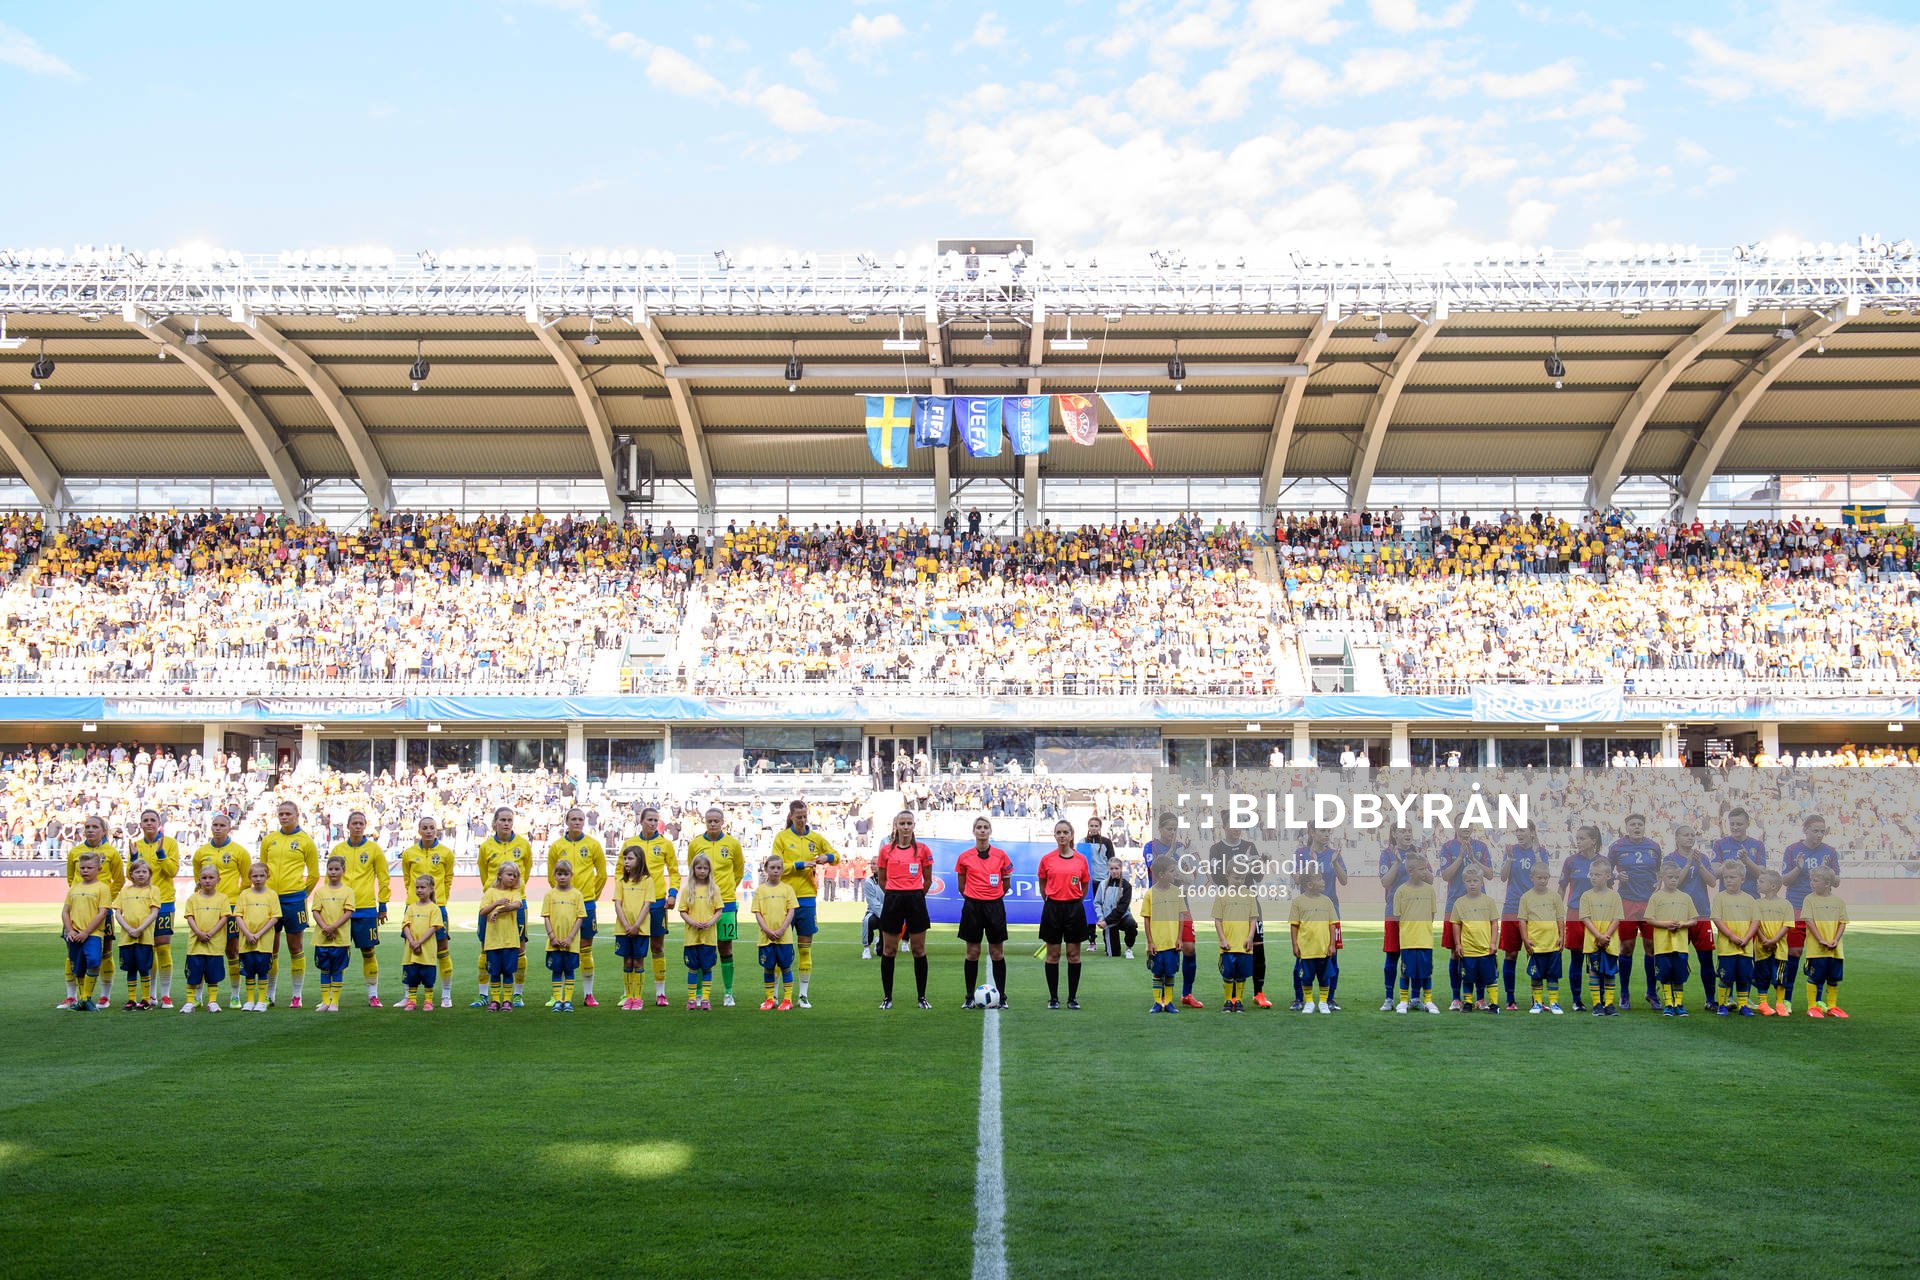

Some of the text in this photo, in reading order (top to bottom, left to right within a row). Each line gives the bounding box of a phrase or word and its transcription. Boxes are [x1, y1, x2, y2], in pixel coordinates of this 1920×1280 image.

[930, 406, 945, 439] FIFA
[970, 400, 986, 452] UEFA
[1021, 411, 1032, 453] RESPECT
[118, 701, 230, 714] NATIONALSPORTEN
[269, 701, 381, 714] NATIONALSPORTEN
[1167, 700, 1278, 714] NATIONALSPORTEN
[1622, 700, 1736, 713] NATIONALSPORTEN
[1519, 857, 1531, 870] 16
[1635, 851, 1643, 864] 2
[1805, 857, 1818, 870] 18
[1, 869, 28, 877] OLIKA
[157, 916, 170, 929] 22
[296, 911, 307, 925] 18
[722, 923, 735, 937] 12
